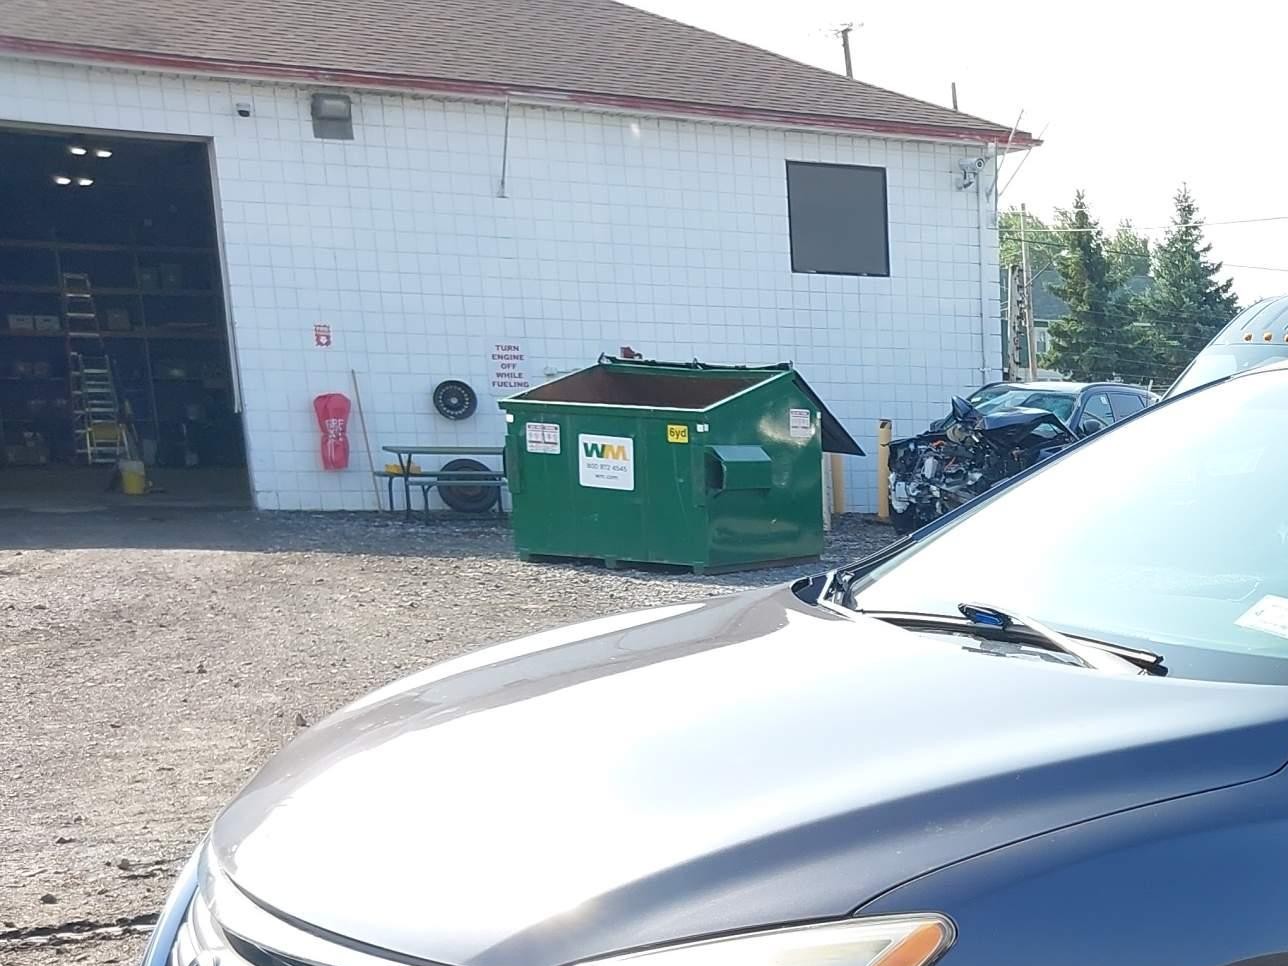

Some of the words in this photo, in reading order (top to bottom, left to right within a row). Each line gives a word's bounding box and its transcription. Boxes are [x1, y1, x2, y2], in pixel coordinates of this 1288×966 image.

[494, 344, 520, 352] TURN
[491, 353, 525, 361] ENGINE
[500, 362, 517, 370] OFF
[669, 427, 687, 441] 6yd
[583, 442, 629, 461] WM
